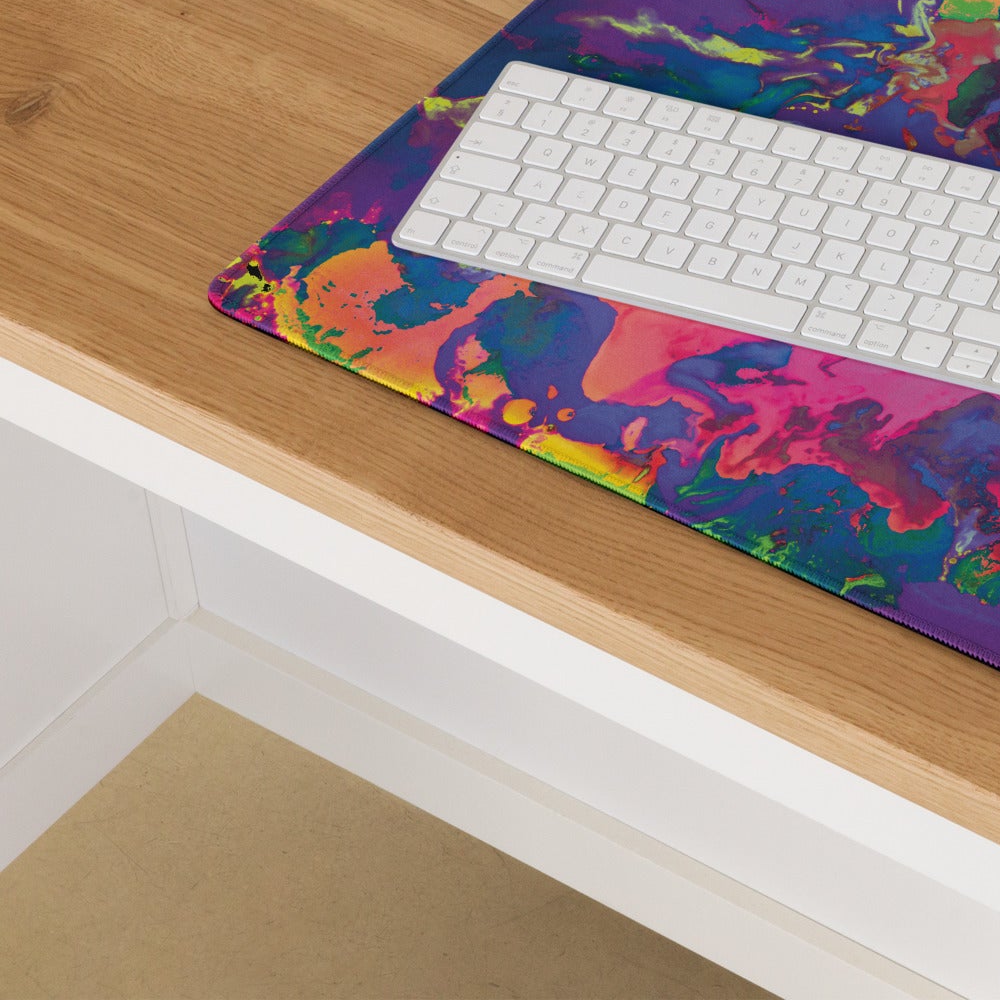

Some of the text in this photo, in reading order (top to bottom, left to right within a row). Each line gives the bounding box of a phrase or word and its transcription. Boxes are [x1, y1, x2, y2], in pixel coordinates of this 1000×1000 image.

[541, 120, 546, 128] 1
[543, 148, 552, 157] Q
[585, 158, 597, 166] W
[533, 181, 541, 189] A
[705, 221, 715, 231] G
[880, 263, 886, 271] L
[536, 216, 545, 224] Z
[578, 226, 588, 234] X
[622, 236, 631, 244] C
[752, 268, 762, 276] N
[795, 278, 807, 286] M
[451, 240, 478, 249] control
[494, 251, 520, 260] option
[535, 261, 574, 274] command
[806, 326, 846, 339] command
[862, 339, 888, 349] option
